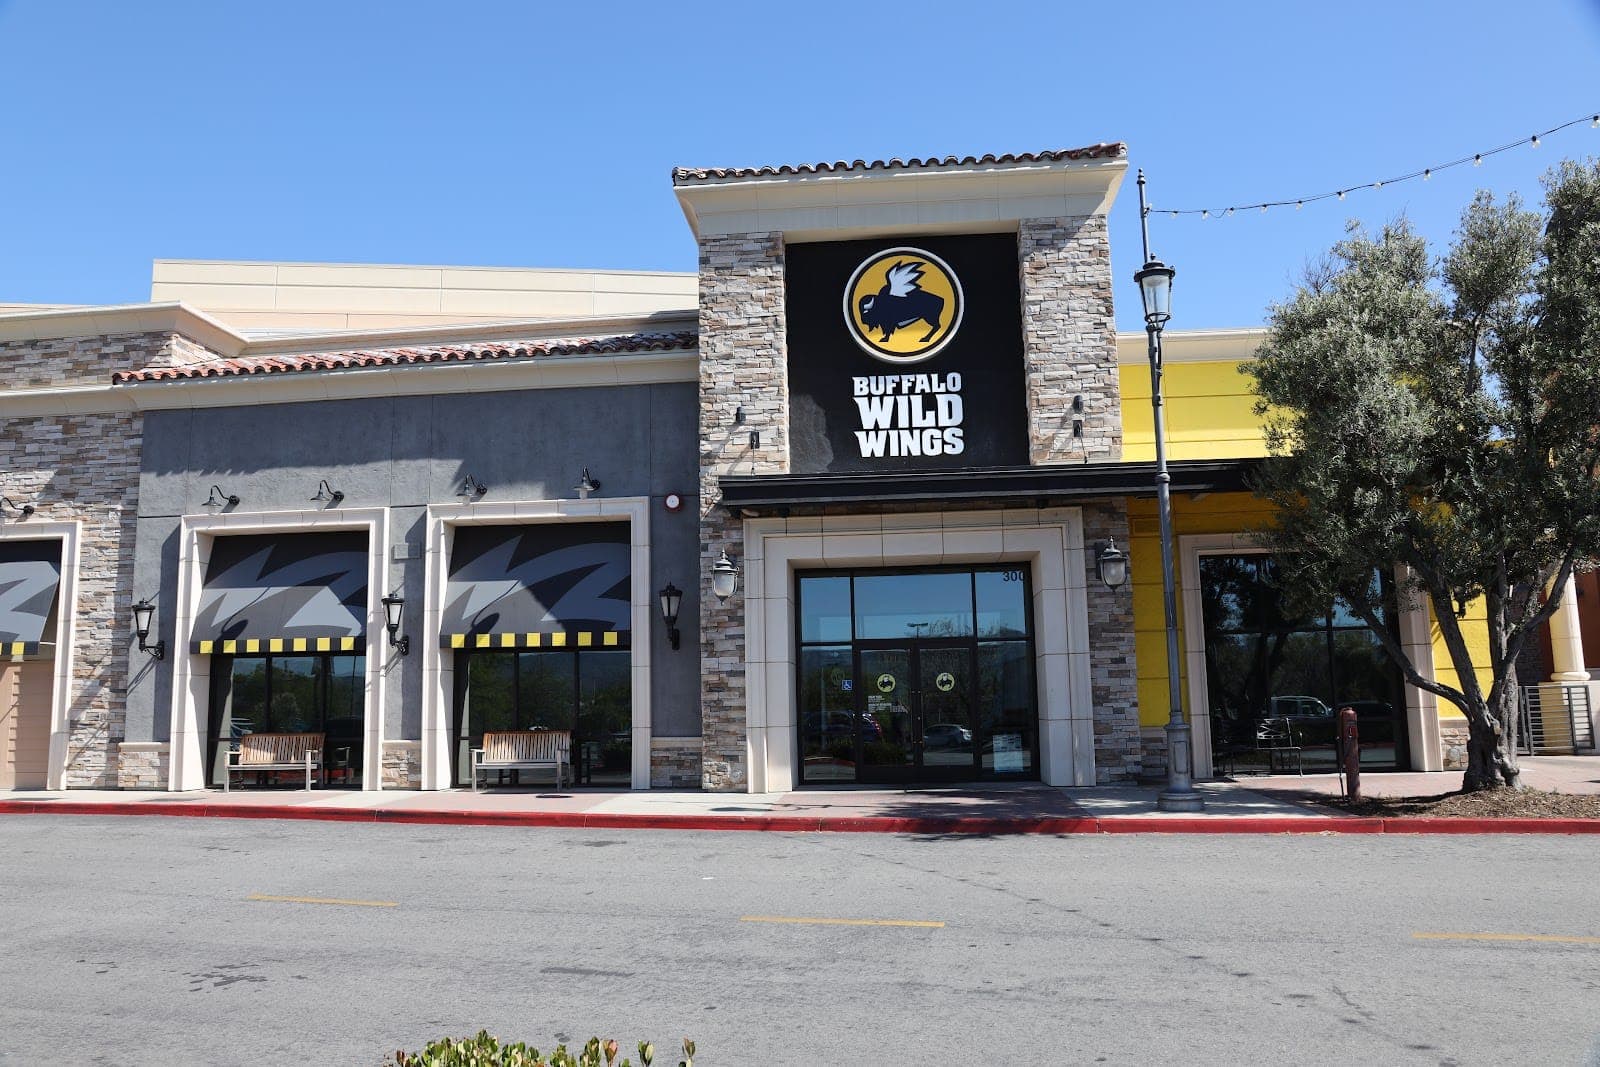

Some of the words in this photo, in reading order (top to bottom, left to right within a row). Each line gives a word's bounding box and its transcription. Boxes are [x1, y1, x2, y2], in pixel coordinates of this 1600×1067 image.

[852, 372, 961, 396] BUFFALO
[853, 393, 963, 430] WILD
[853, 427, 965, 458] WINGS
[1002, 571, 1025, 582] 300
